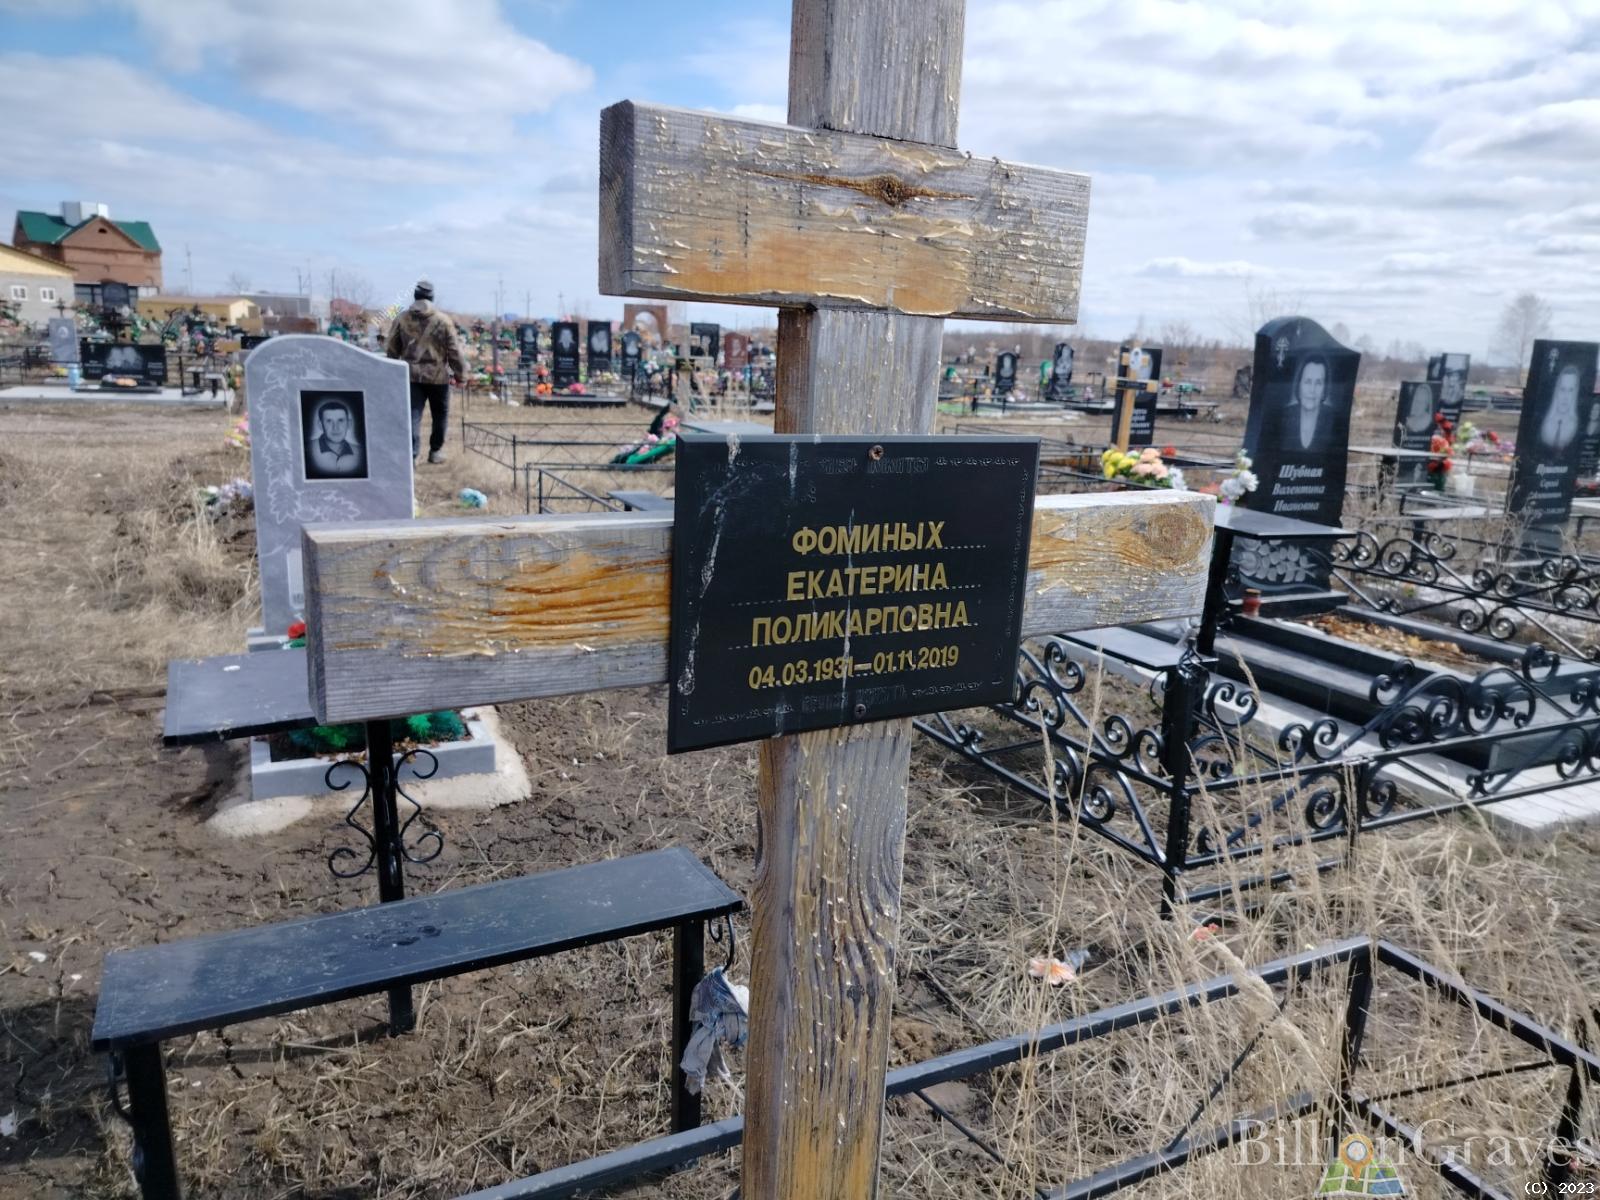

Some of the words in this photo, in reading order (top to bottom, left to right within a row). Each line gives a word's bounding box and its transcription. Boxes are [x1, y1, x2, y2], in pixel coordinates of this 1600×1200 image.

[792, 521, 944, 555] ФОМИНЫХ
[787, 563, 948, 600] ЕКАТЕРИНА
[752, 601, 968, 647] ПОЛИКАРПОВНА
